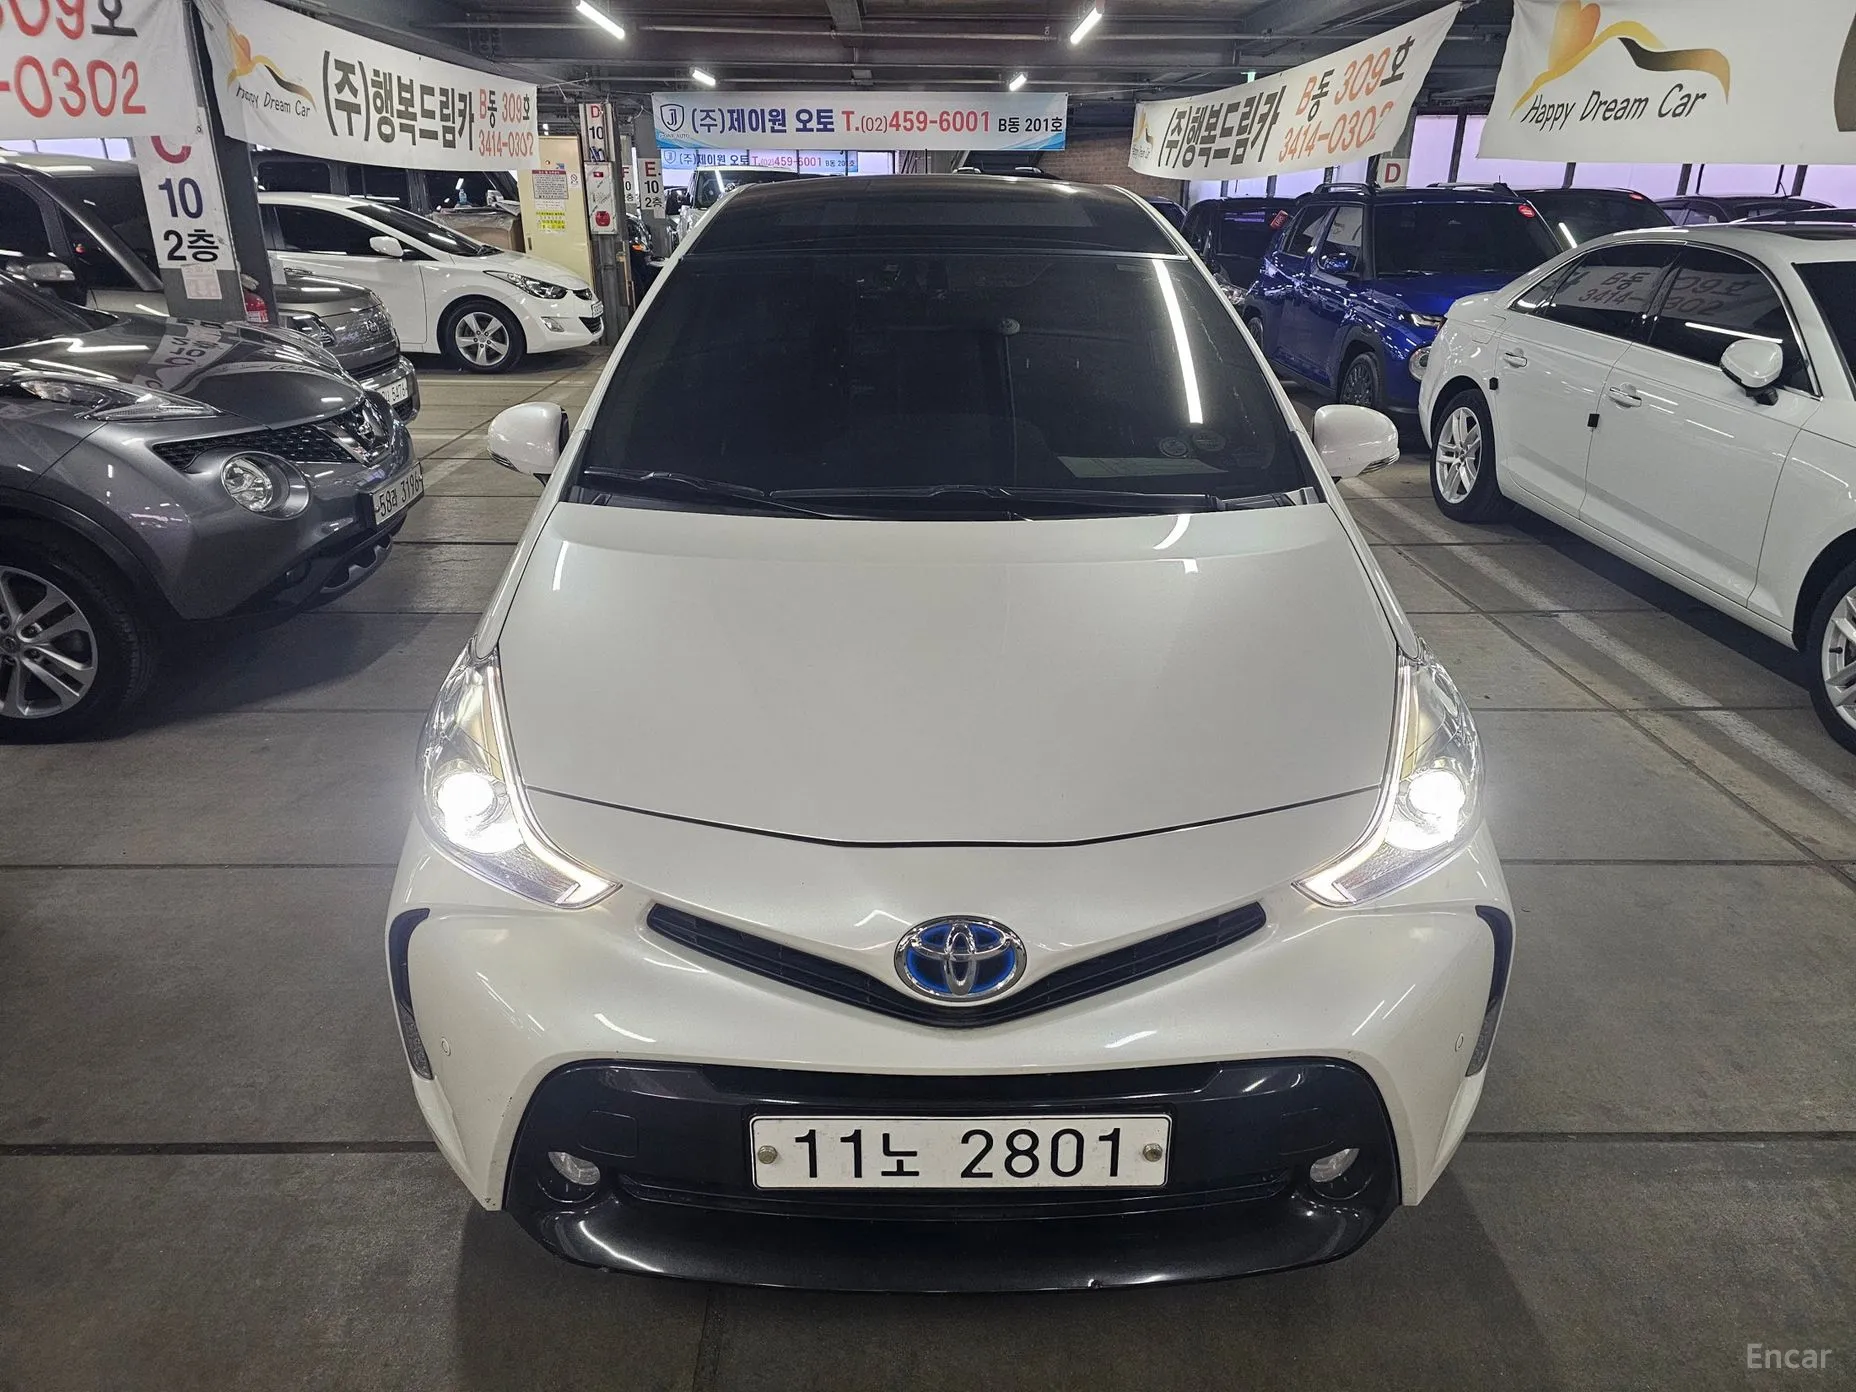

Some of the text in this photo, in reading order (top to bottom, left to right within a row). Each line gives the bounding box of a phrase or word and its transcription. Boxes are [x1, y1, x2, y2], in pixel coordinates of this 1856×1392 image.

[1295, 35, 1415, 122] B동 309호
[263, 91, 291, 114] Dream
[295, 100, 311, 118] Car
[322, 50, 475, 151] (주)행복드림카
[480, 89, 530, 129] B동 309호
[591, 105, 600, 118] D
[1520, 82, 1707, 132] Happy Dream Car
[589, 125, 604, 140] 10
[691, 107, 1064, 134] (주)제이원 오토 T.(02)459-6001 B동 201호
[478, 129, 534, 158] 3414-0302
[644, 180, 660, 194] 10
[1385, 162, 1402, 184] D
[158, 177, 203, 219] 10
[163, 228, 220, 262] 2층
[401, 471, 420, 503] 3196
[794, 1127, 1121, 1179] 11노 2801
